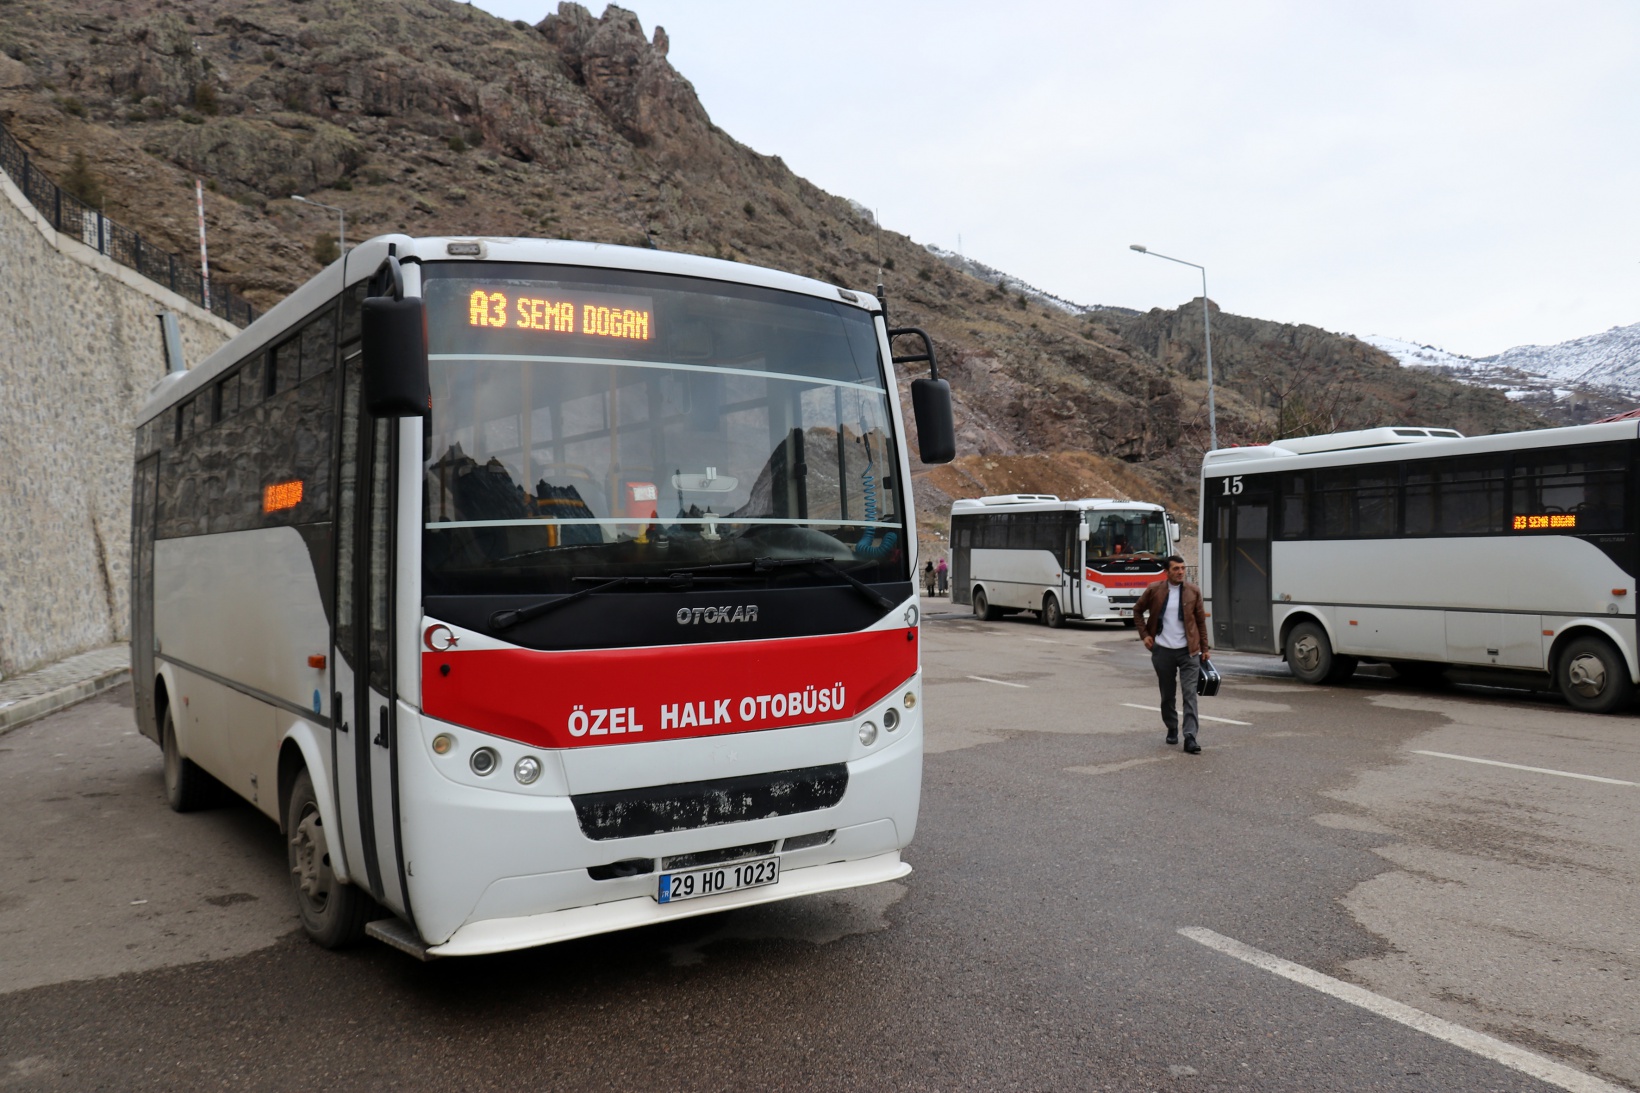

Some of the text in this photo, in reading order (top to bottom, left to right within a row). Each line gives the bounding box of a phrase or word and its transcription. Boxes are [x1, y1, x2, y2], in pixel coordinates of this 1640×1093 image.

[469, 290, 648, 340] A3 SEMA DOĞAN
[1222, 475, 1244, 496] 15
[1513, 515, 1527, 530] A3
[1528, 515, 1549, 528] SEMA
[676, 604, 759, 625] OTOKAR
[567, 681, 846, 737] ÖZEL HALK OTOBÜSÜ
[671, 874, 695, 898] 29
[734, 861, 776, 888] 1023
